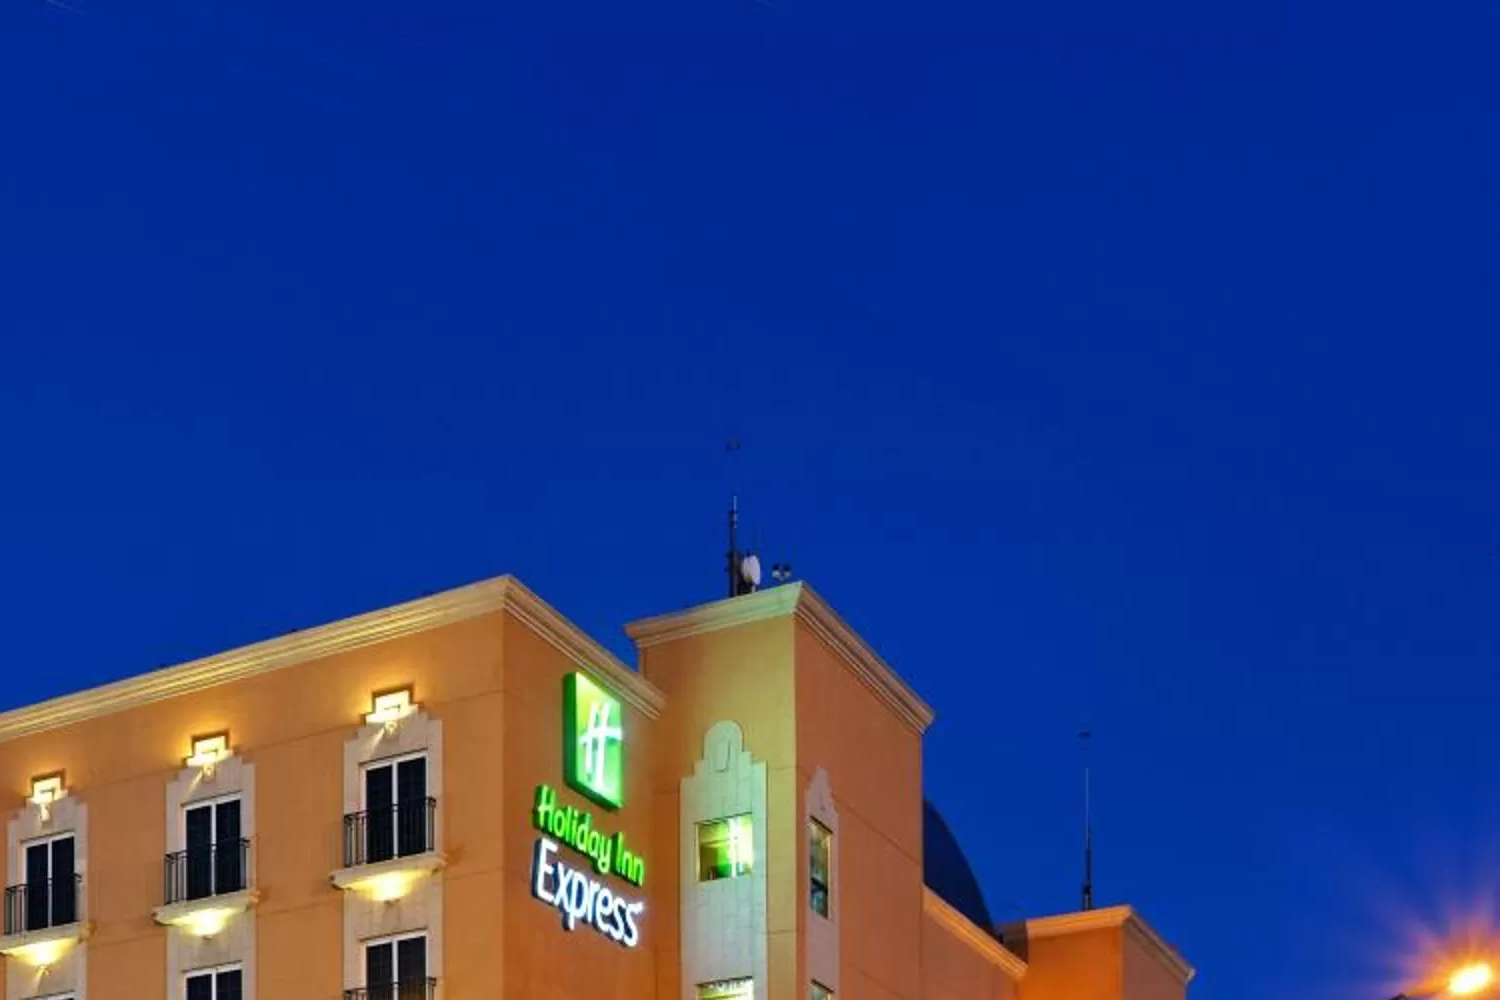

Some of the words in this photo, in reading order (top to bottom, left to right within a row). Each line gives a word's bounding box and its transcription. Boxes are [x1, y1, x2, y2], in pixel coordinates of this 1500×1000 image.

[536, 784, 613, 874] Holiday
[615, 831, 645, 887] Inn
[535, 837, 645, 948] Express
